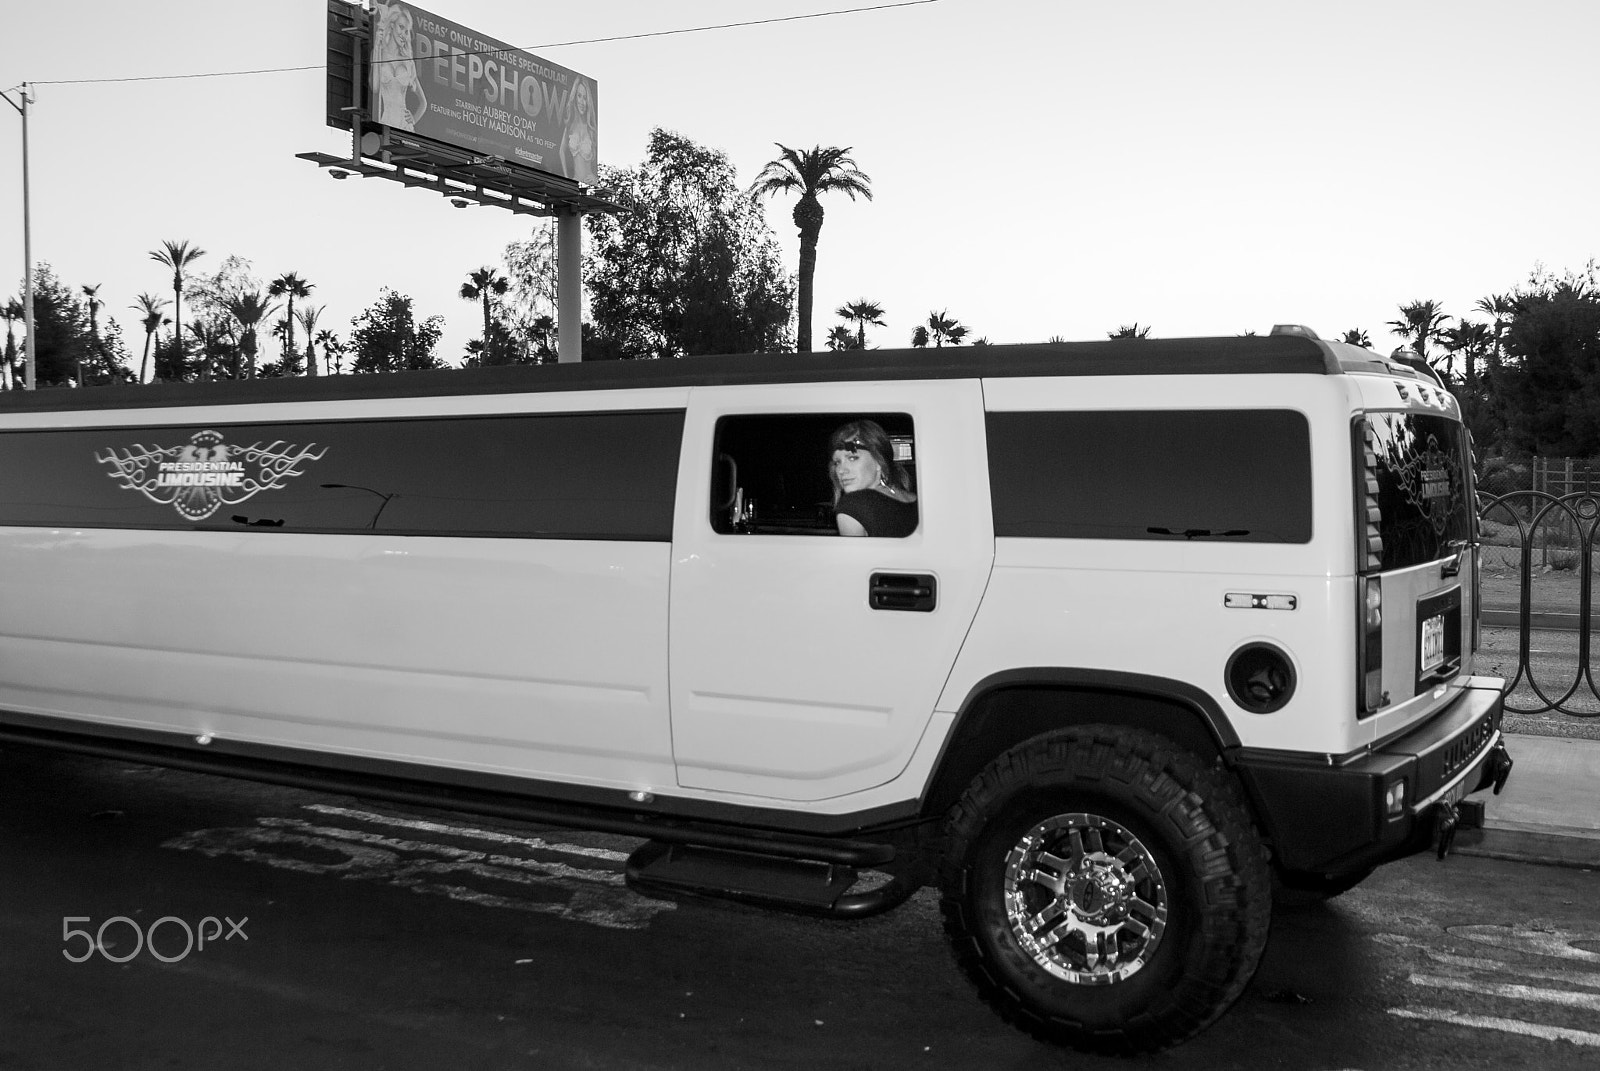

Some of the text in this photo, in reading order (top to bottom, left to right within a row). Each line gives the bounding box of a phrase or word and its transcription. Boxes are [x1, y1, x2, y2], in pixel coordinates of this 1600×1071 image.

[416, 16, 568, 83] VEGAS' ONLY STRIPTEASE SPECTACULAR!
[415, 32, 568, 126] PEEPSHOW
[430, 103, 462, 120] FEATURING
[462, 110, 488, 128] HOLLY
[488, 119, 527, 140] MADISON
[527, 135, 534, 143] AS
[455, 98, 537, 132] STARRING AUBREY O'DAY
[157, 472, 245, 487] LIMOUSINE
[158, 461, 245, 472] PRESIDENTIAL
